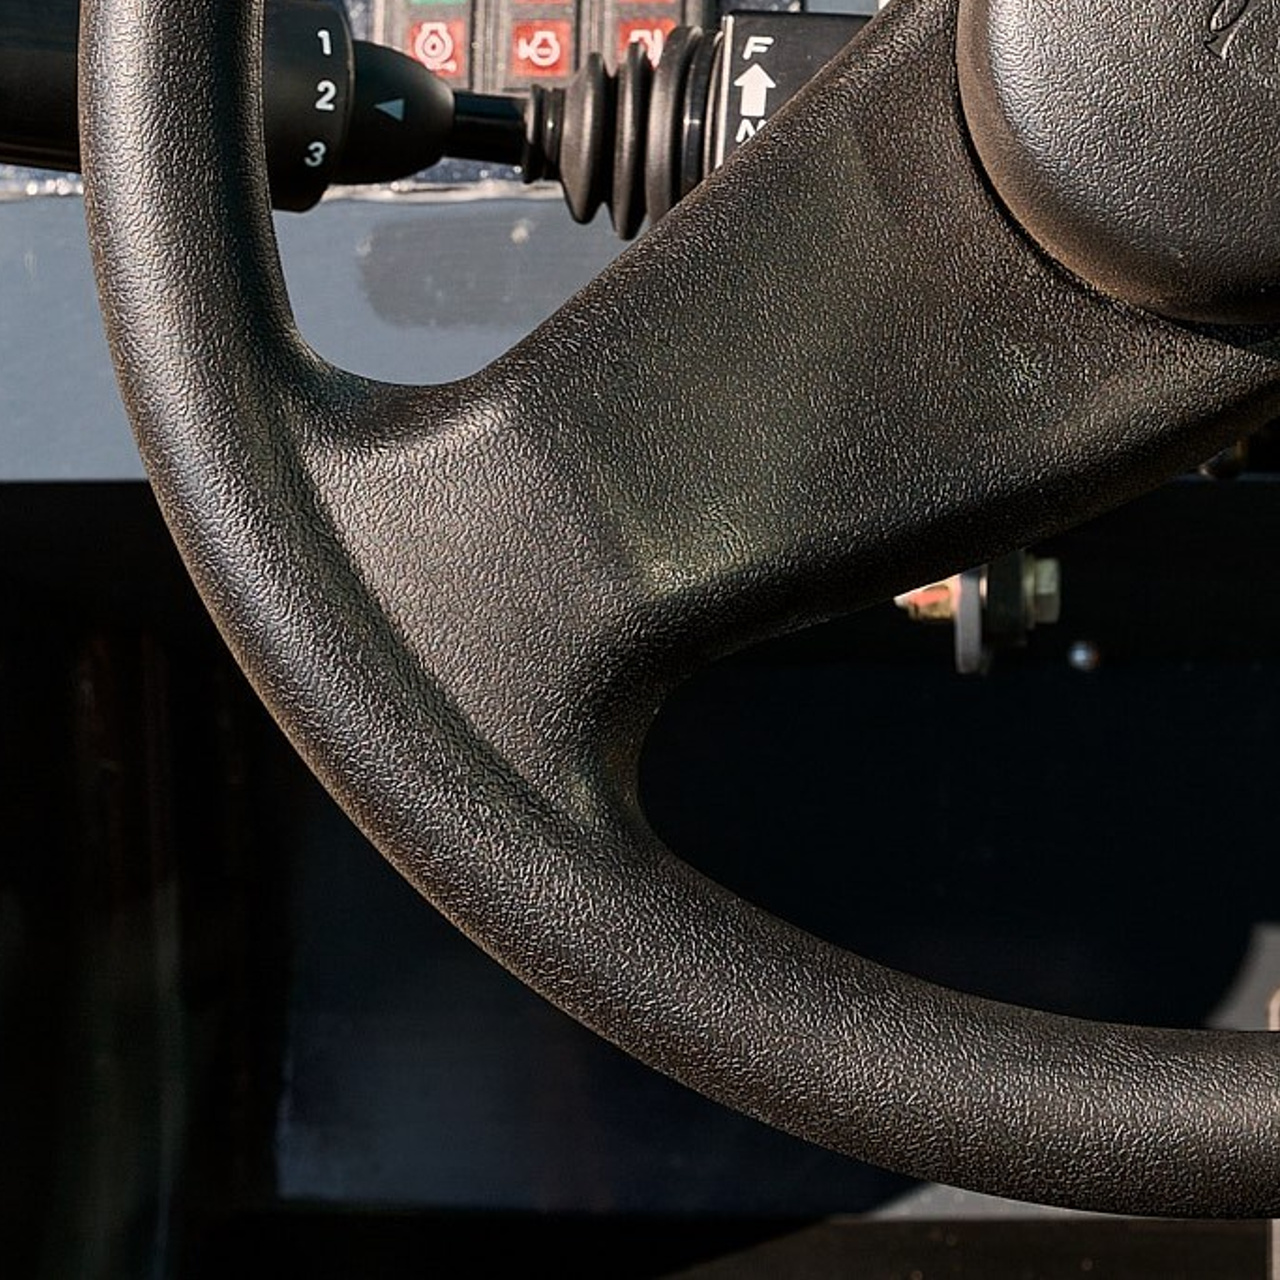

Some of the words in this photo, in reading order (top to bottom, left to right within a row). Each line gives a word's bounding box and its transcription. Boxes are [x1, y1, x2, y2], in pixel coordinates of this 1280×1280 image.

[316, 28, 333, 56] 1
[742, 35, 775, 61] F
[314, 78, 338, 112] 2
[304, 141, 327, 167] 3
